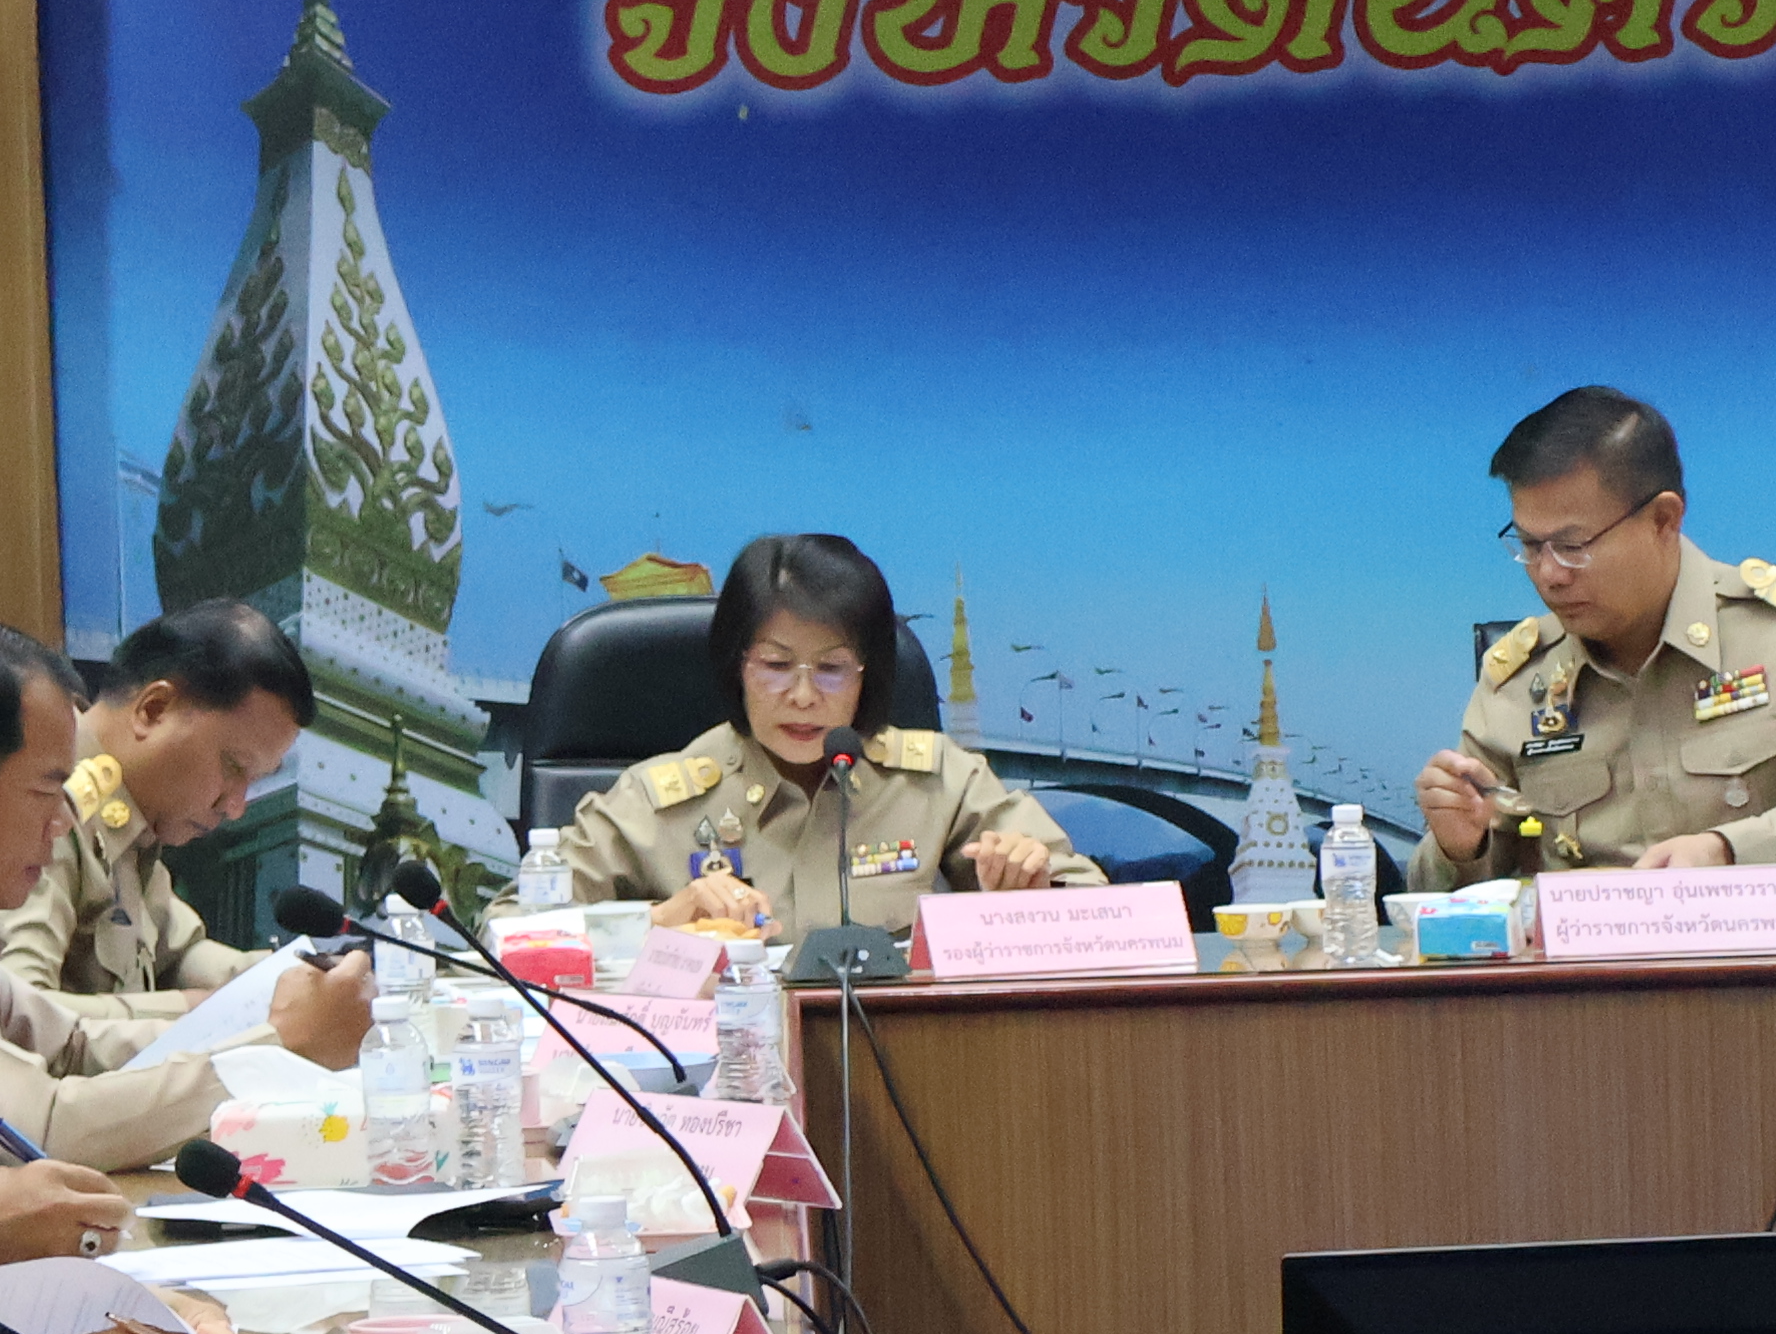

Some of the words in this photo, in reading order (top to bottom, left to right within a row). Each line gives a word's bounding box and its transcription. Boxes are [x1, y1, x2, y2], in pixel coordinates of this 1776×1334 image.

[1549, 883, 1665, 905] นายปราชญา
[979, 908, 1060, 927] นางสงวน
[1066, 904, 1133, 922] มะเสนา
[942, 935, 1184, 965] รองผู้ว่าราชการจังหวัดนครพนม
[678, 1109, 743, 1138] ทองปรีชา
